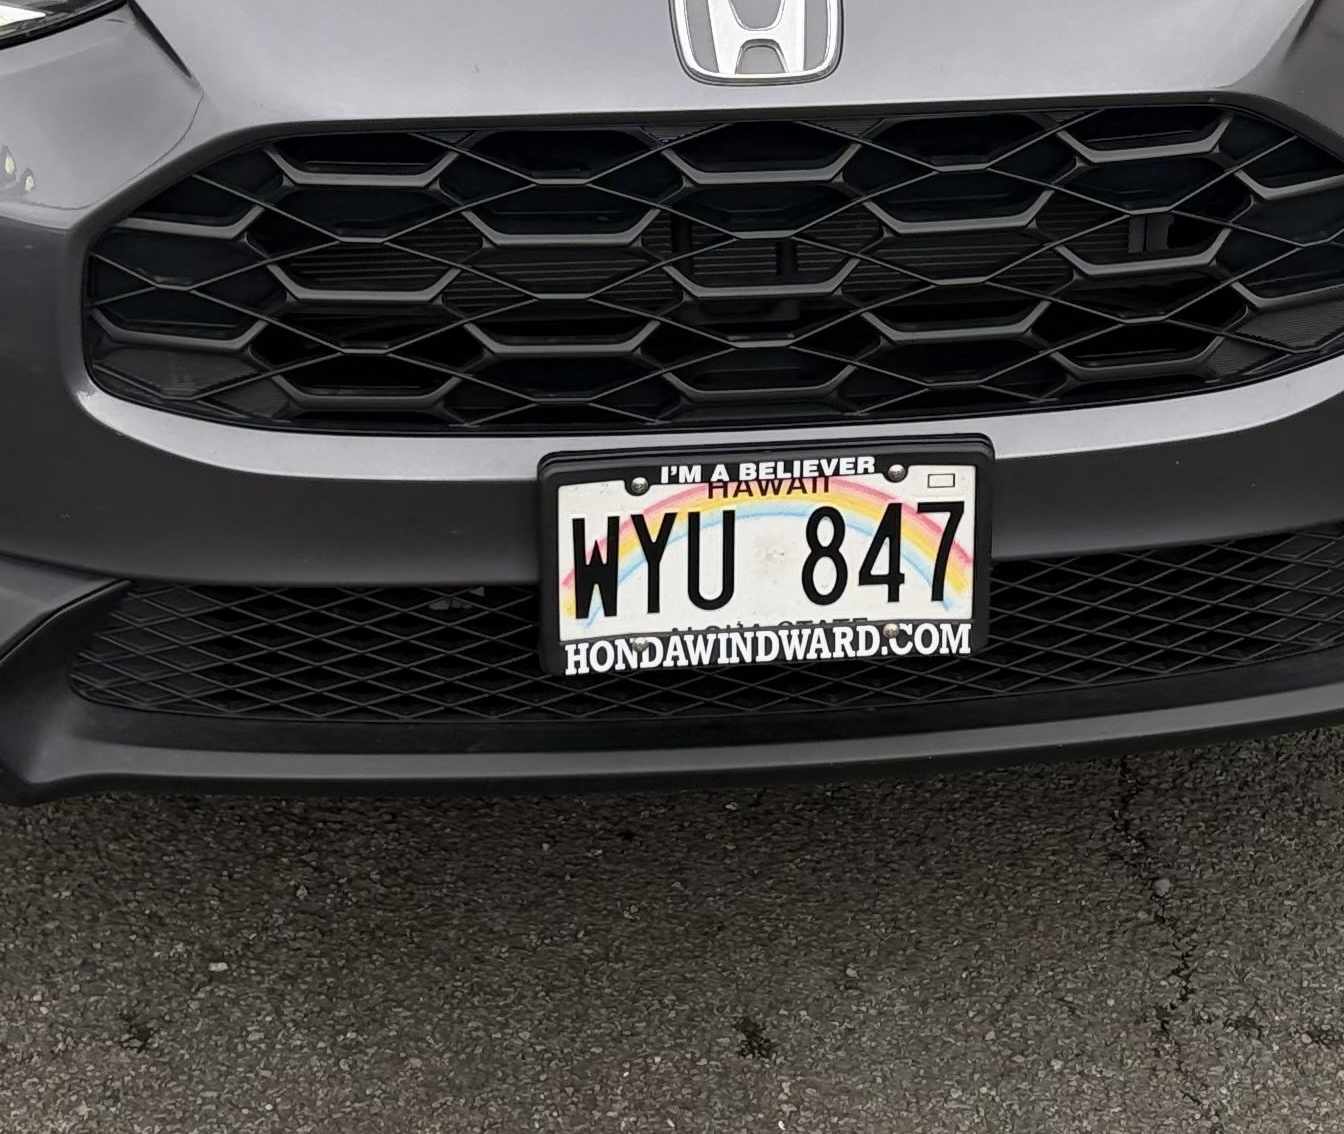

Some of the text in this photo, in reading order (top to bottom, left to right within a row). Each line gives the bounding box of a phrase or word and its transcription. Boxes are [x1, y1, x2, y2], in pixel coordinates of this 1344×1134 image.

[660, 456, 876, 484] I'M A BELIEVER
[708, 476, 830, 499] HAWAII
[572, 501, 965, 619] WYU 847
[565, 622, 972, 676] HONDAWINDWARD.COM
